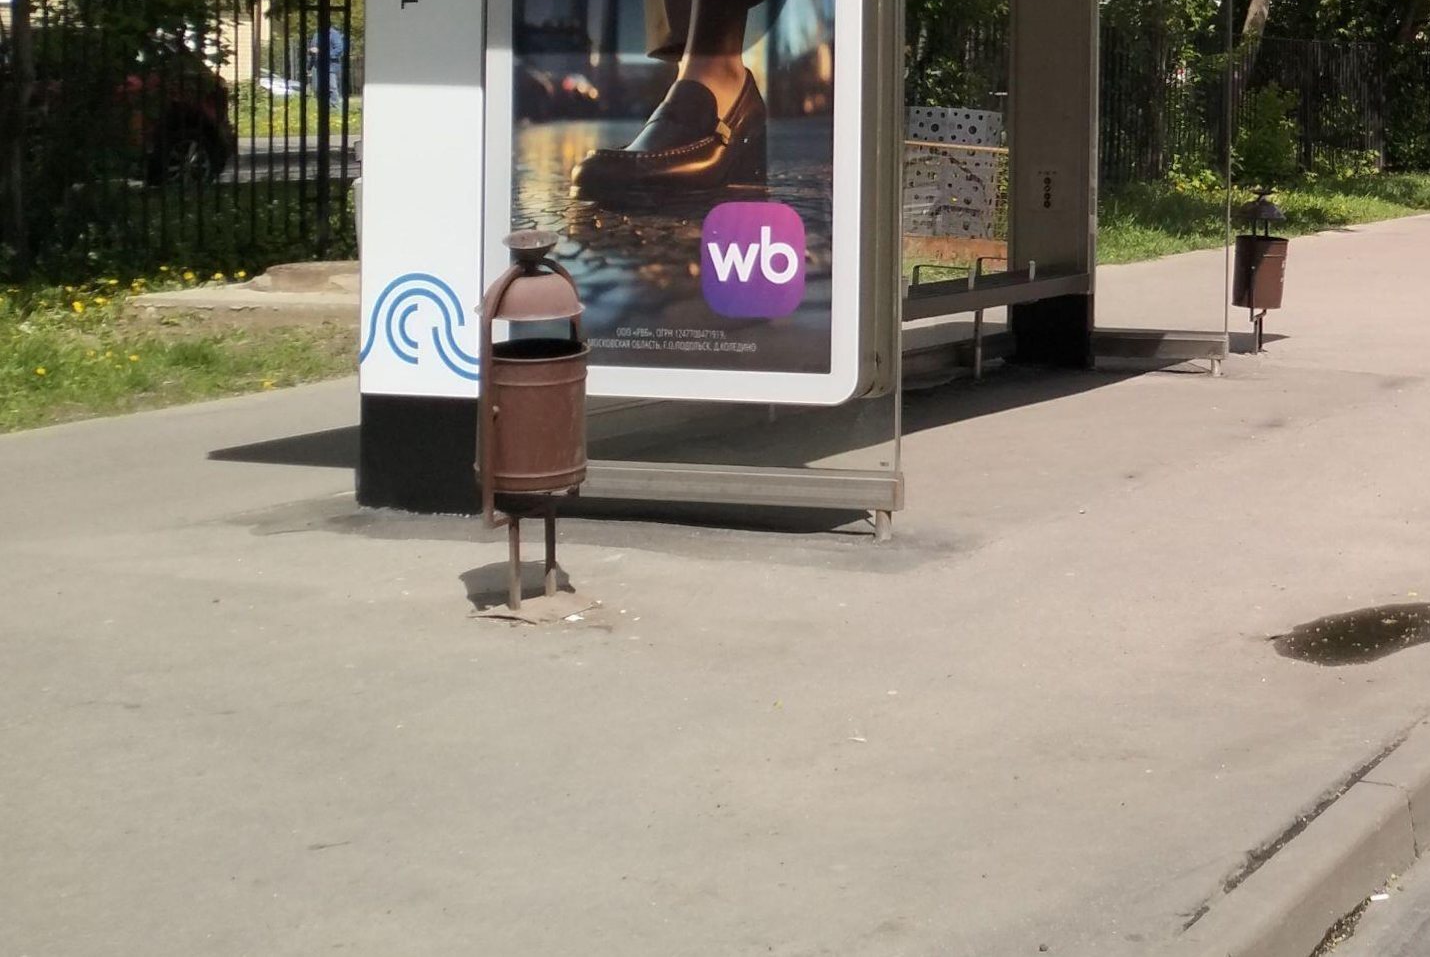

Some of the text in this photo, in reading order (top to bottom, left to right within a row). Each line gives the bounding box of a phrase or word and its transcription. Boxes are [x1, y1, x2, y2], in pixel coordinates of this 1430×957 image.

[707, 226, 799, 284] wb
[616, 327, 632, 337] ООО
[656, 328, 674, 338] ОГРН
